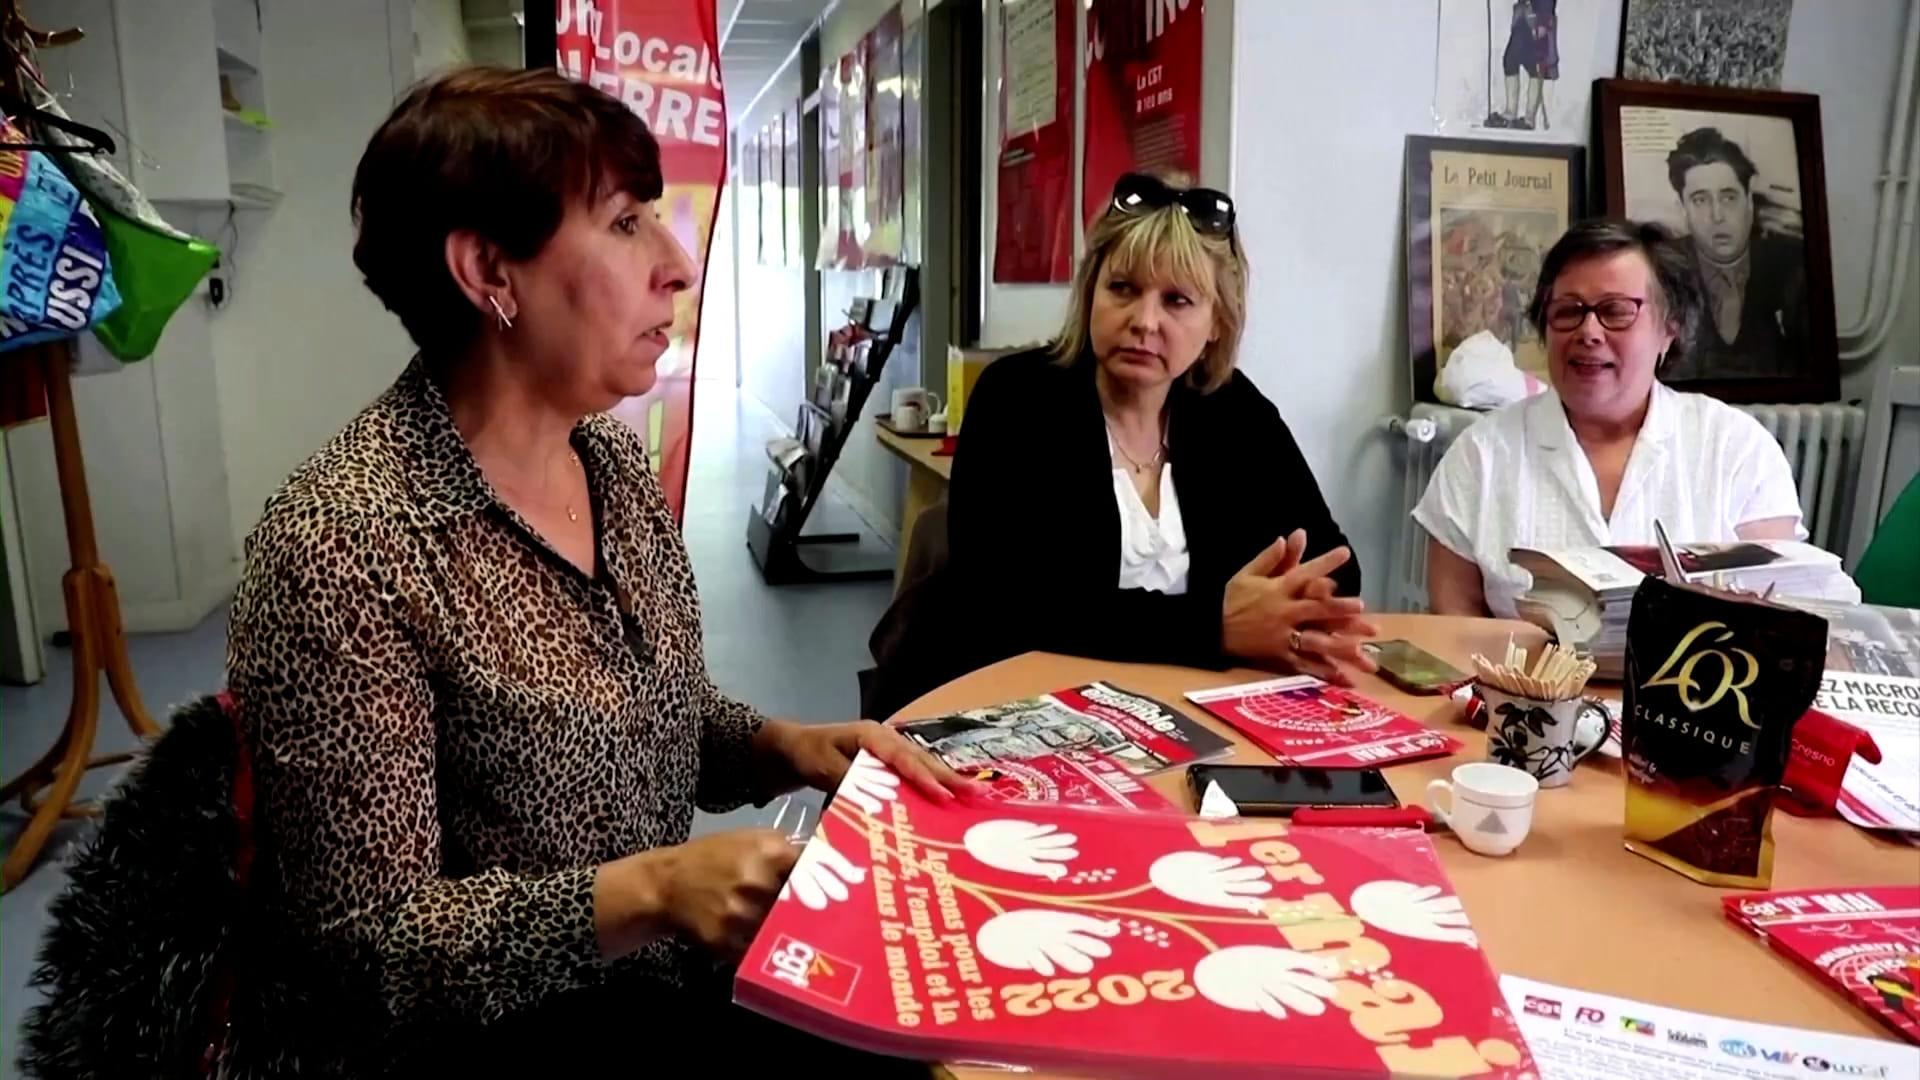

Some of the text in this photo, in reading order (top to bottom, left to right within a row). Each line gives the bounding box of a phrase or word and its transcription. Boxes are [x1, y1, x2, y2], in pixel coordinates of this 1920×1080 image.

[1147, 65, 1162, 86] CGT
[1444, 166, 1553, 191] Le Petit Journal
[1831, 696, 1863, 711] LA
[1844, 680, 1920, 701] MACRO
[1634, 703, 1752, 756] CLASSIQUE
[870, 864, 898, 917] dans
[1811, 893, 1886, 913] MAI
[881, 918, 904, 947] le
[904, 884, 950, 972] l'emploi
[925, 847, 996, 1022] Agissons pour les
[771, 942, 815, 990] cgt
[886, 947, 923, 1028] monde
[925, 973, 949, 999] et
[1001, 968, 1195, 1017] 2022
[931, 999, 958, 1025] la
[1576, 1007, 1604, 1023] FO
